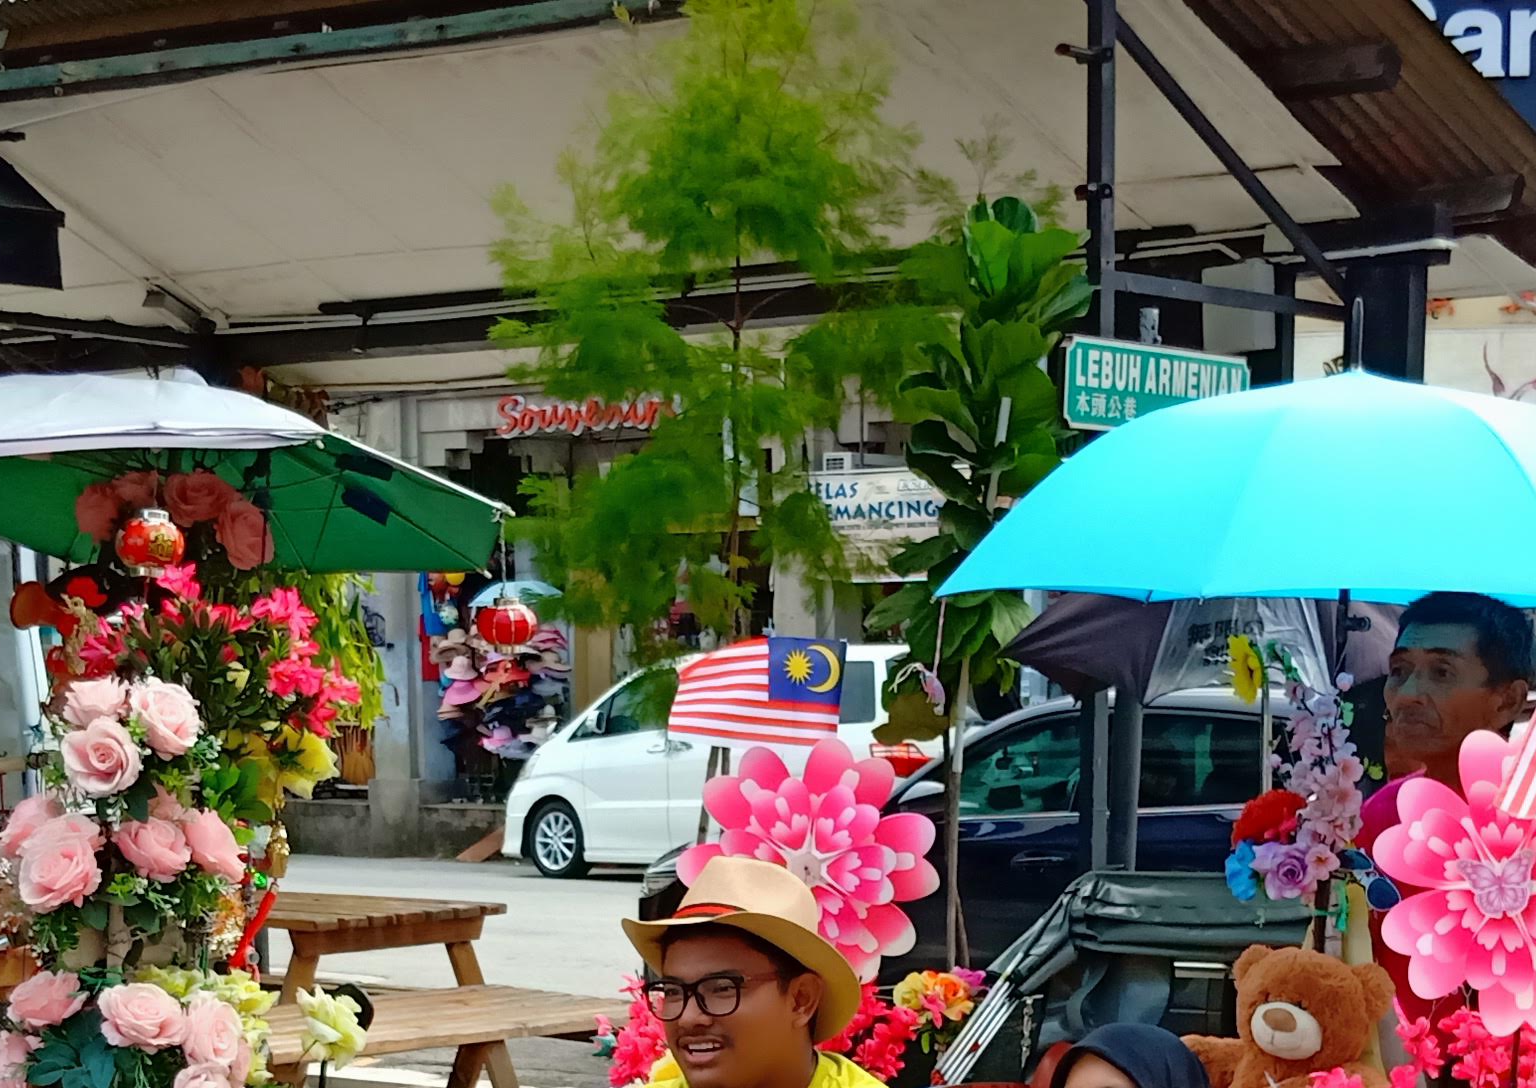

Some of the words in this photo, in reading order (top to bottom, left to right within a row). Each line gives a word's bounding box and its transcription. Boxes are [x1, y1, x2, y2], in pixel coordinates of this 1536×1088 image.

[1075, 348, 1142, 393] LEBUH
[1144, 357, 1243, 400] ARMENIAN
[1075, 390, 1137, 421] 本頭公巷
[808, 480, 859, 501] ELAS
[824, 499, 939, 522] EMANCING
